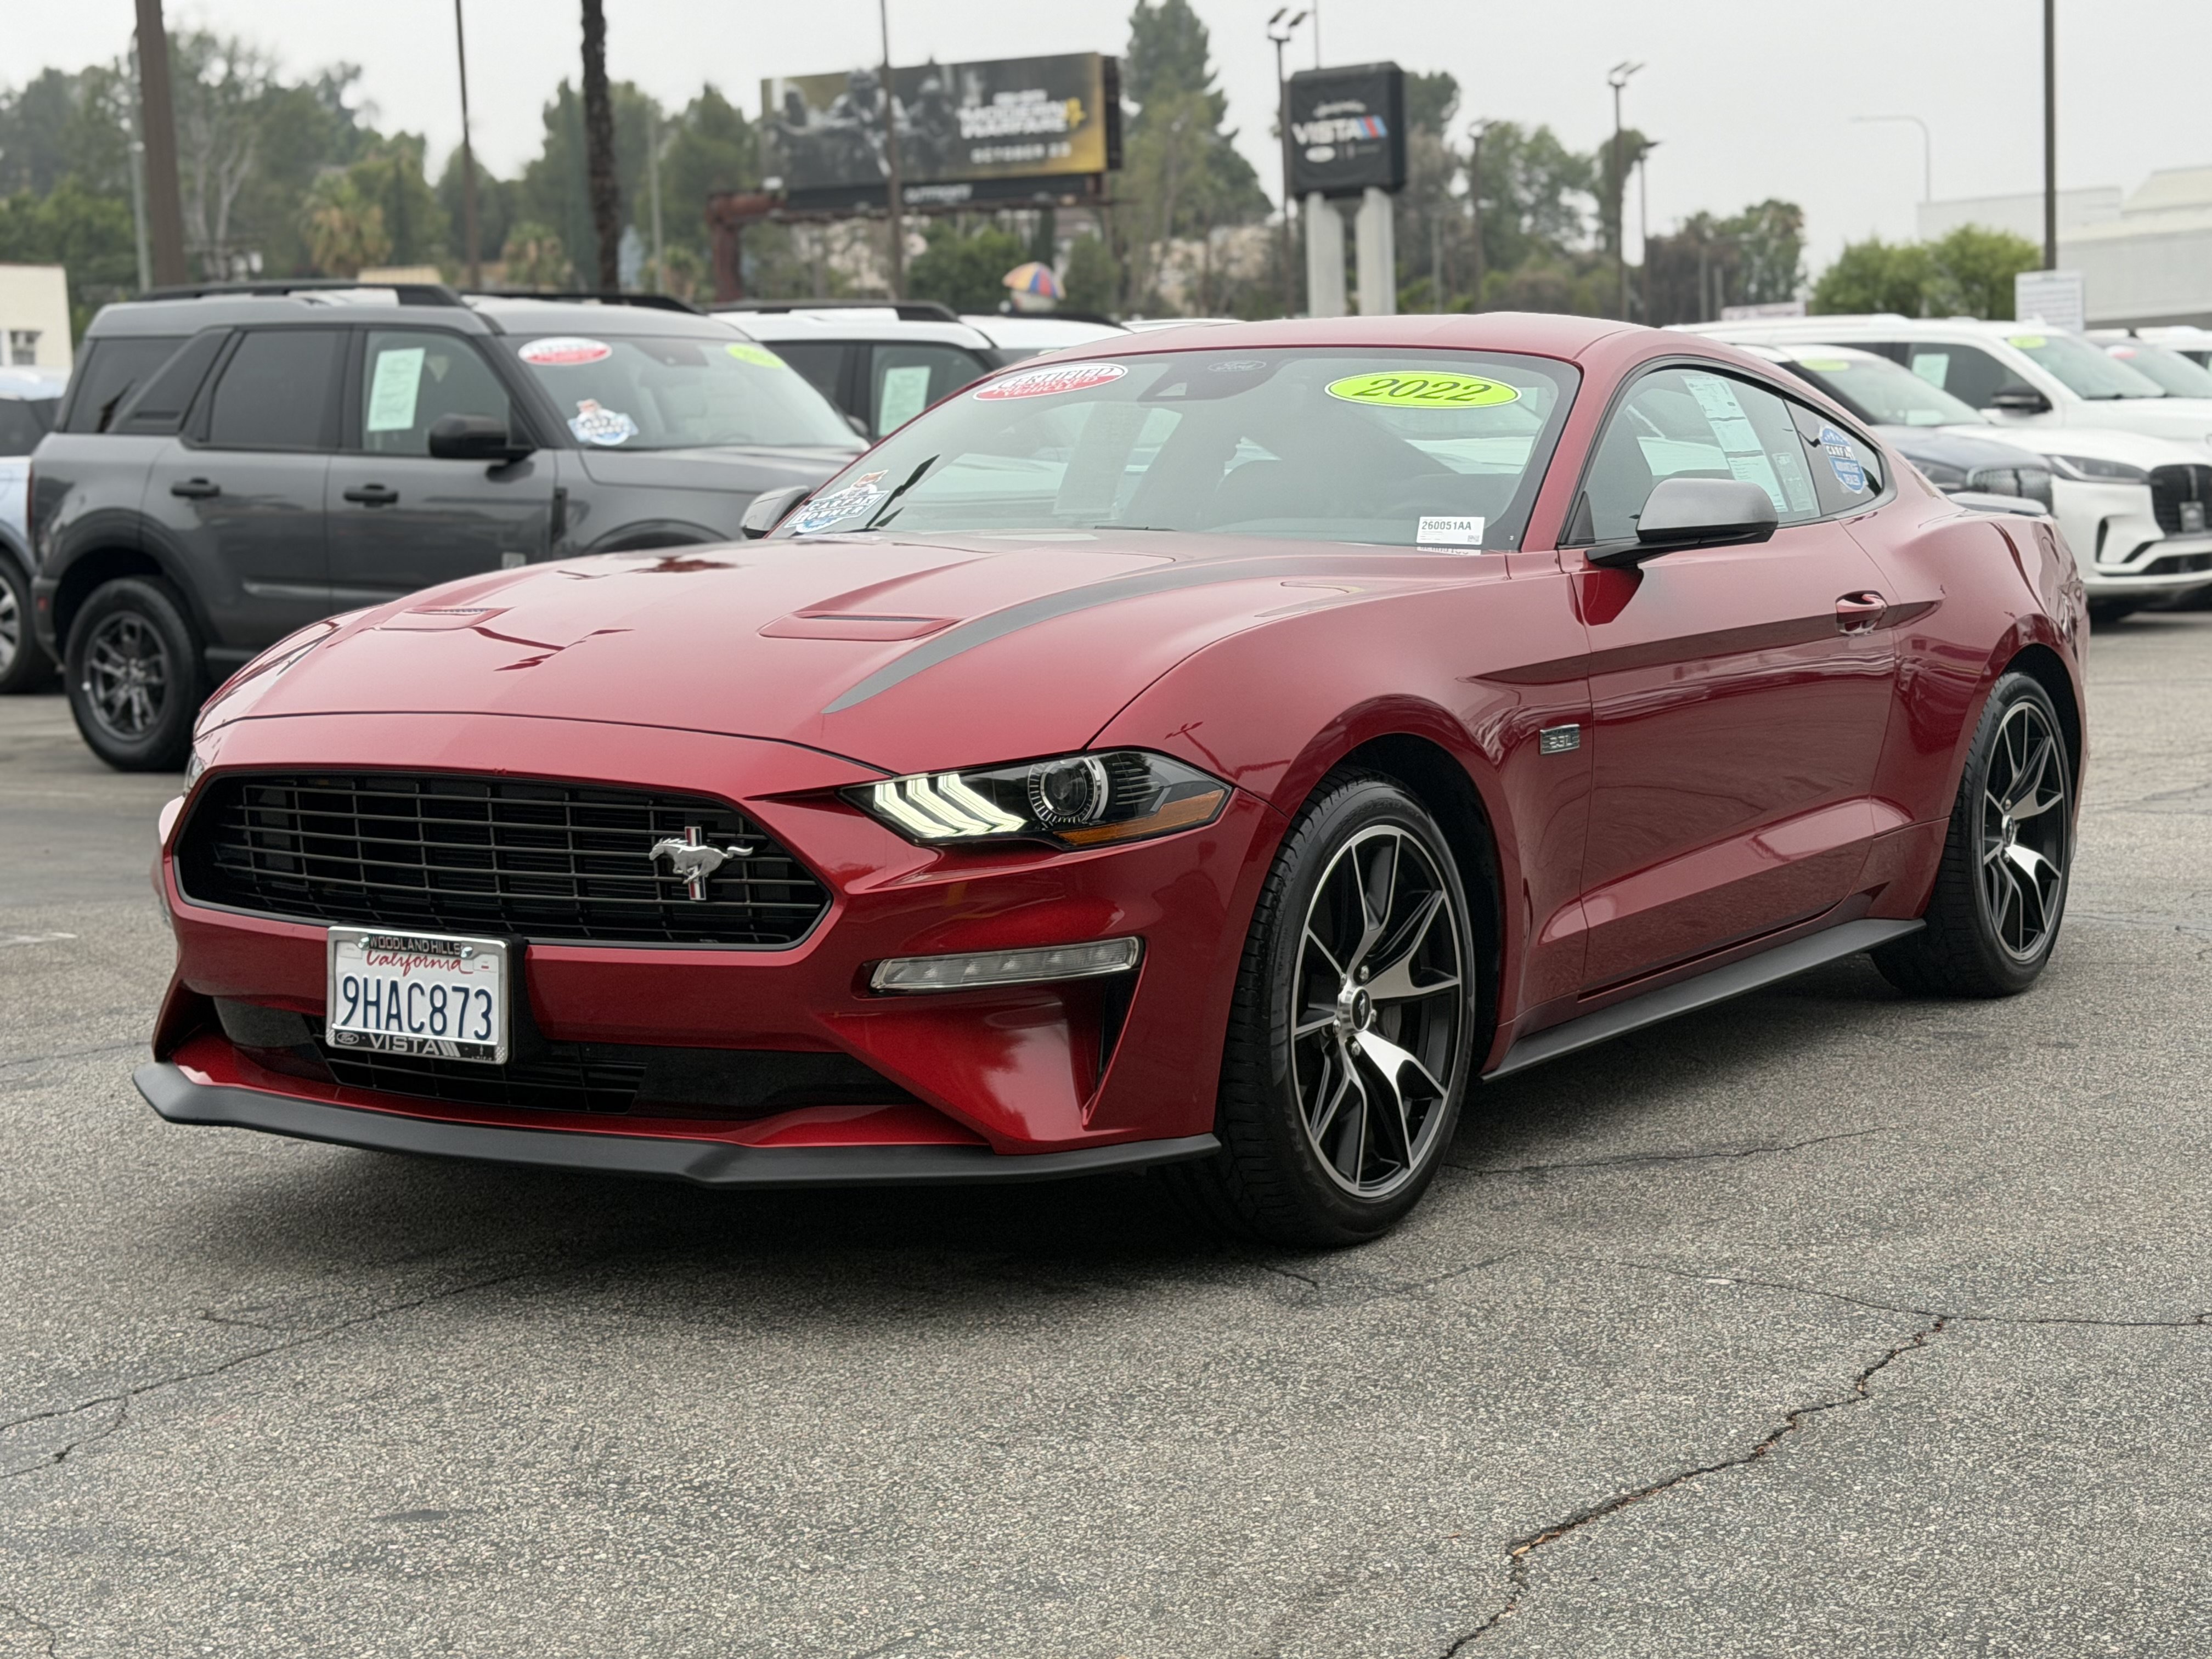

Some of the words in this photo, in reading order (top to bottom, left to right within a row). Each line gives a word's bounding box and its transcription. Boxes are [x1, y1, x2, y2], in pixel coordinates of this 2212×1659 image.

[1291, 117, 1365, 145] VISTA
[1352, 378, 1492, 402] 2022
[1421, 521, 1471, 531] 260051AA
[369, 936, 430, 953] WOODLAND
[431, 941, 461, 956] HILLS
[366, 950, 474, 977] California
[341, 975, 493, 1041] 9HAC873
[369, 1034, 441, 1056] VISTA
